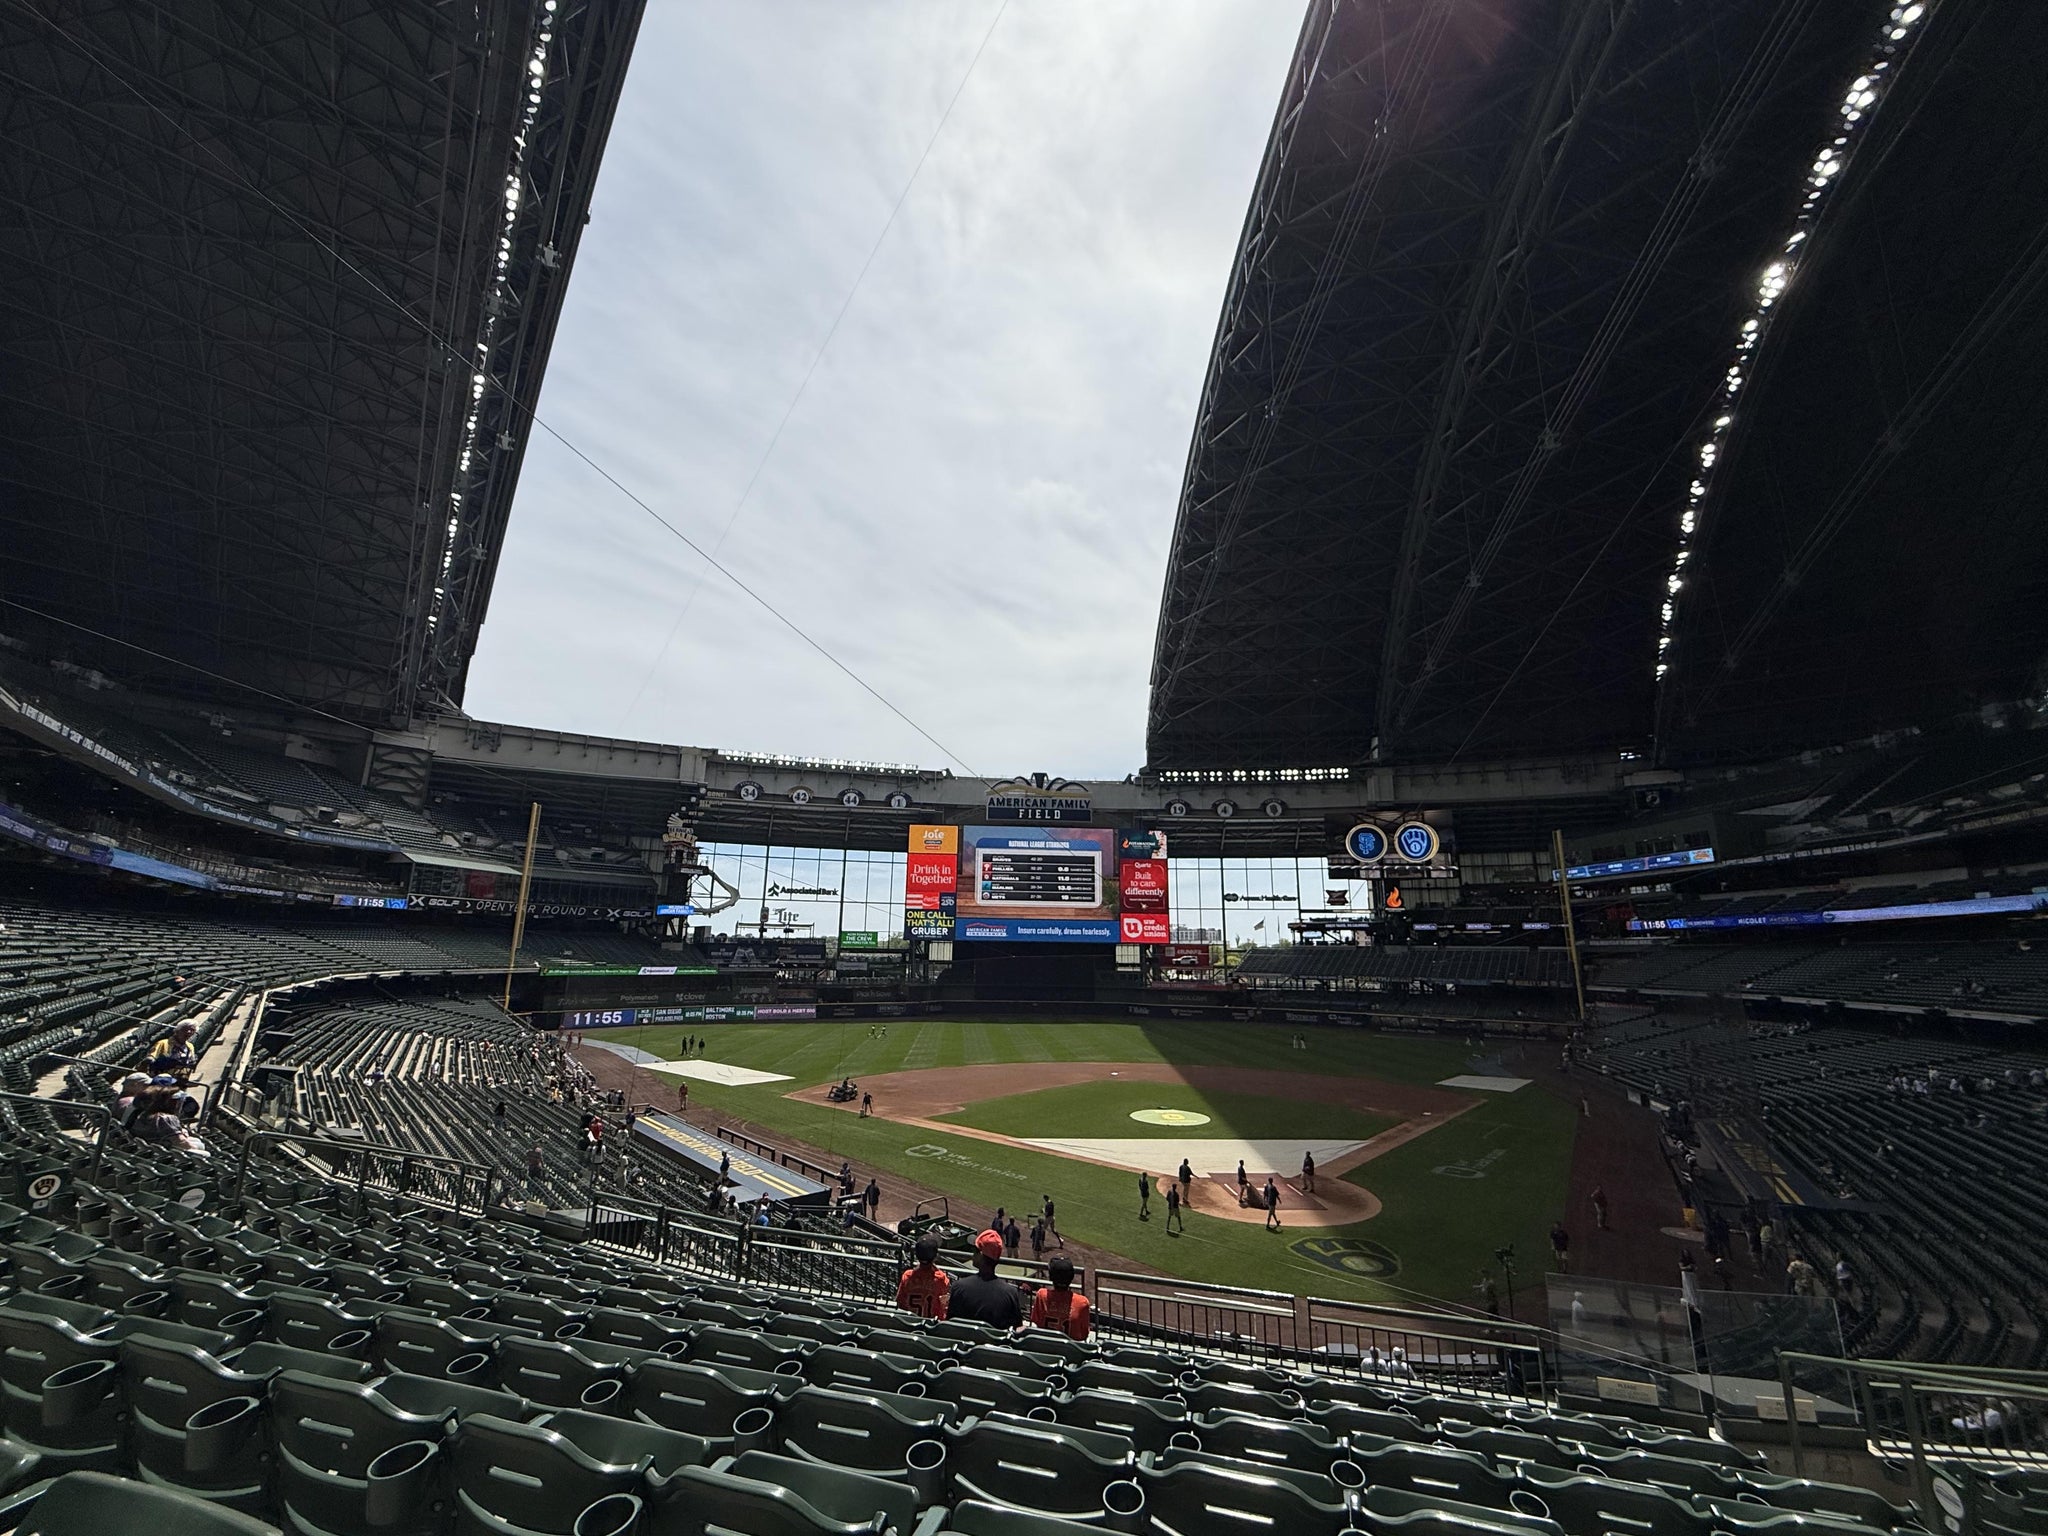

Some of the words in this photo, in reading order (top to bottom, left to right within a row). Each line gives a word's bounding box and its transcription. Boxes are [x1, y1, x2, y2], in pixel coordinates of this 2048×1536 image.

[743, 788, 756, 797] 34
[795, 791, 807, 801] 42
[845, 796, 857, 805] 44
[988, 797, 1046, 807] AMERICAN
[1051, 798, 1091, 809] FAMILY
[1019, 809, 1061, 819] FIELD
[1172, 806, 1184, 814] 19
[922, 828, 945, 839] Joie
[913, 864, 940, 875] Drink
[942, 864, 951, 875] in
[910, 874, 954, 886] Together
[1125, 887, 1165, 897] differently
[357, 897, 385, 908] 11:55
[408, 895, 425, 906] X
[428, 898, 460, 908] GOLF
[476, 900, 506, 912] OPEN
[508, 903, 537, 914] YER
[542, 905, 587, 917] ROUND
[606, 908, 621, 918] X
[906, 911, 926, 919] ONE
[906, 919, 935, 927] THAT'S
[936, 920, 955, 928] ALL!
[1643, 920, 1666, 930] 11:55
[911, 927, 948, 936] GRUBER
[1017, 926, 1036, 934] Insure
[1036, 926, 1063, 936] carefully,
[1063, 927, 1082, 935] dream
[1082, 927, 1111, 937] fearlessly.
[1143, 930, 1167, 938] union
[683, 992, 706, 1000] clover
[573, 1010, 623, 1026] 11:55
[980, 1166, 1028, 1181] union
[908, 1294, 934, 1318] 51
